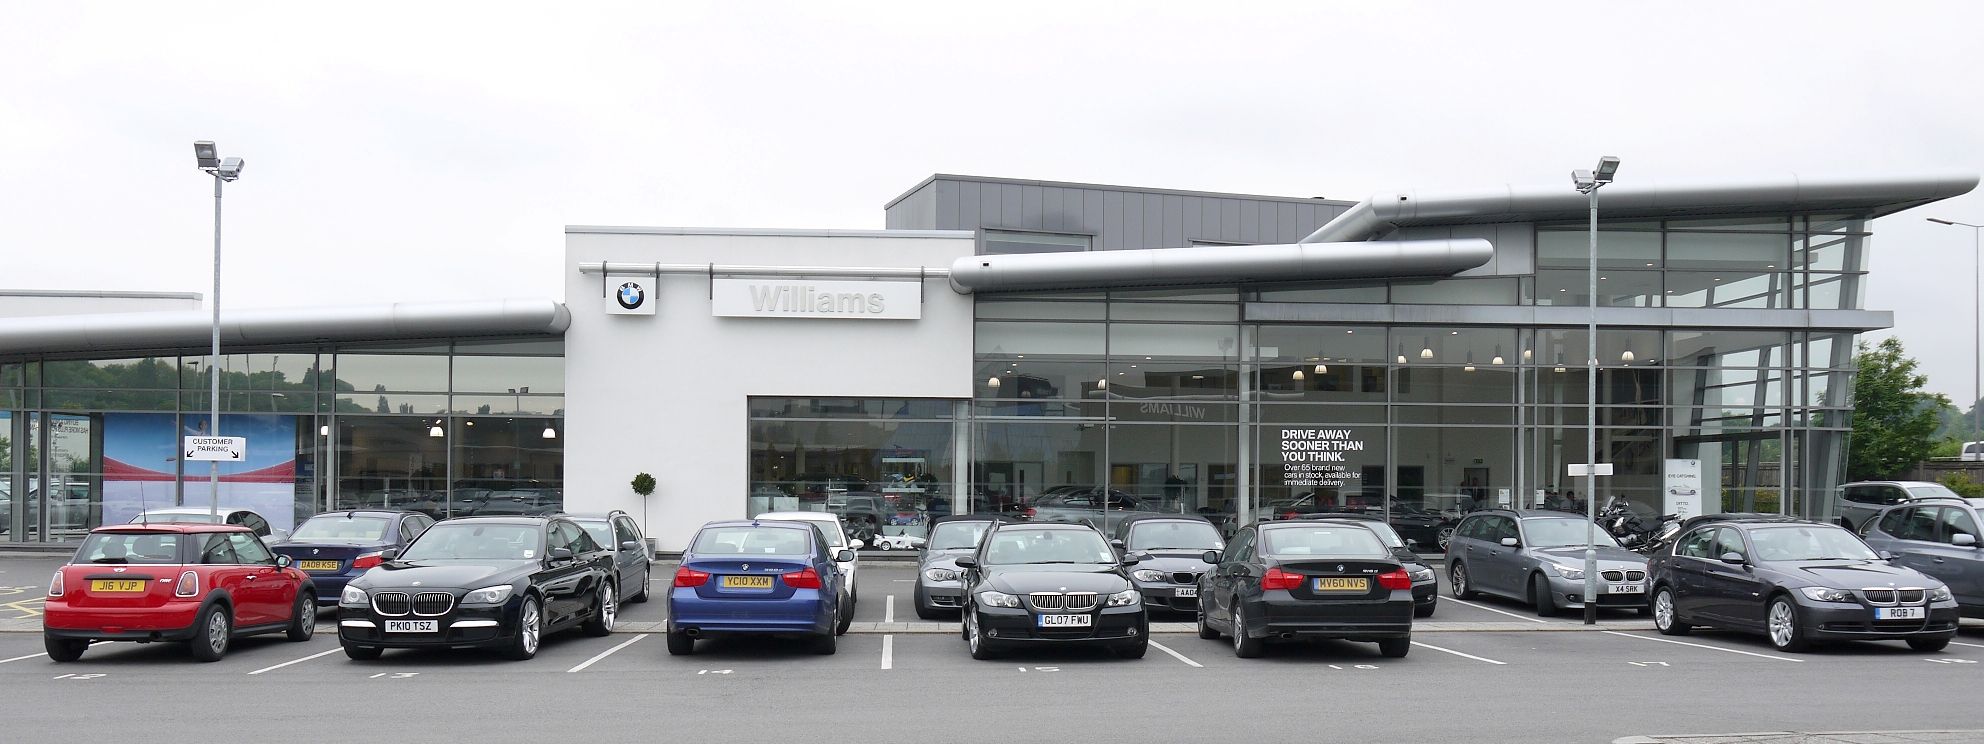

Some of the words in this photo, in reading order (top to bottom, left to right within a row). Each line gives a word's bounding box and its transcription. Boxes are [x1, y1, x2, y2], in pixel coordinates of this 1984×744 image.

[749, 285, 885, 314] Williams
[1281, 429, 1316, 440] DRIVE
[1317, 429, 1352, 440] AWAY
[1281, 440, 1330, 451] SOONER
[1331, 440, 1364, 451] THAN
[1281, 451, 1306, 462] YOU
[1307, 451, 1346, 462] THINK.
[1284, 463, 1301, 471] Over
[1311, 463, 1331, 471] brand
[1298, 471, 1305, 479] in
[1324, 471, 1352, 479] available
[1352, 471, 1361, 479] for
[1318, 479, 1345, 487] delivery.
[301, 561, 321, 569] DA08
[322, 561, 337, 569] KSE
[99, 581, 114, 590] J16
[119, 581, 138, 590] VJP
[727, 576, 748, 586] YC10
[750, 576, 769, 586] XXM
[1319, 578, 1345, 588] MV60
[1347, 579, 1366, 588] NVS
[1890, 608, 1908, 617] ROB
[1909, 608, 1915, 617] 7
[1044, 615, 1069, 625] GL07
[1070, 615, 1089, 625] FWU
[390, 621, 411, 631] PK10
[412, 621, 432, 631] TSZ
